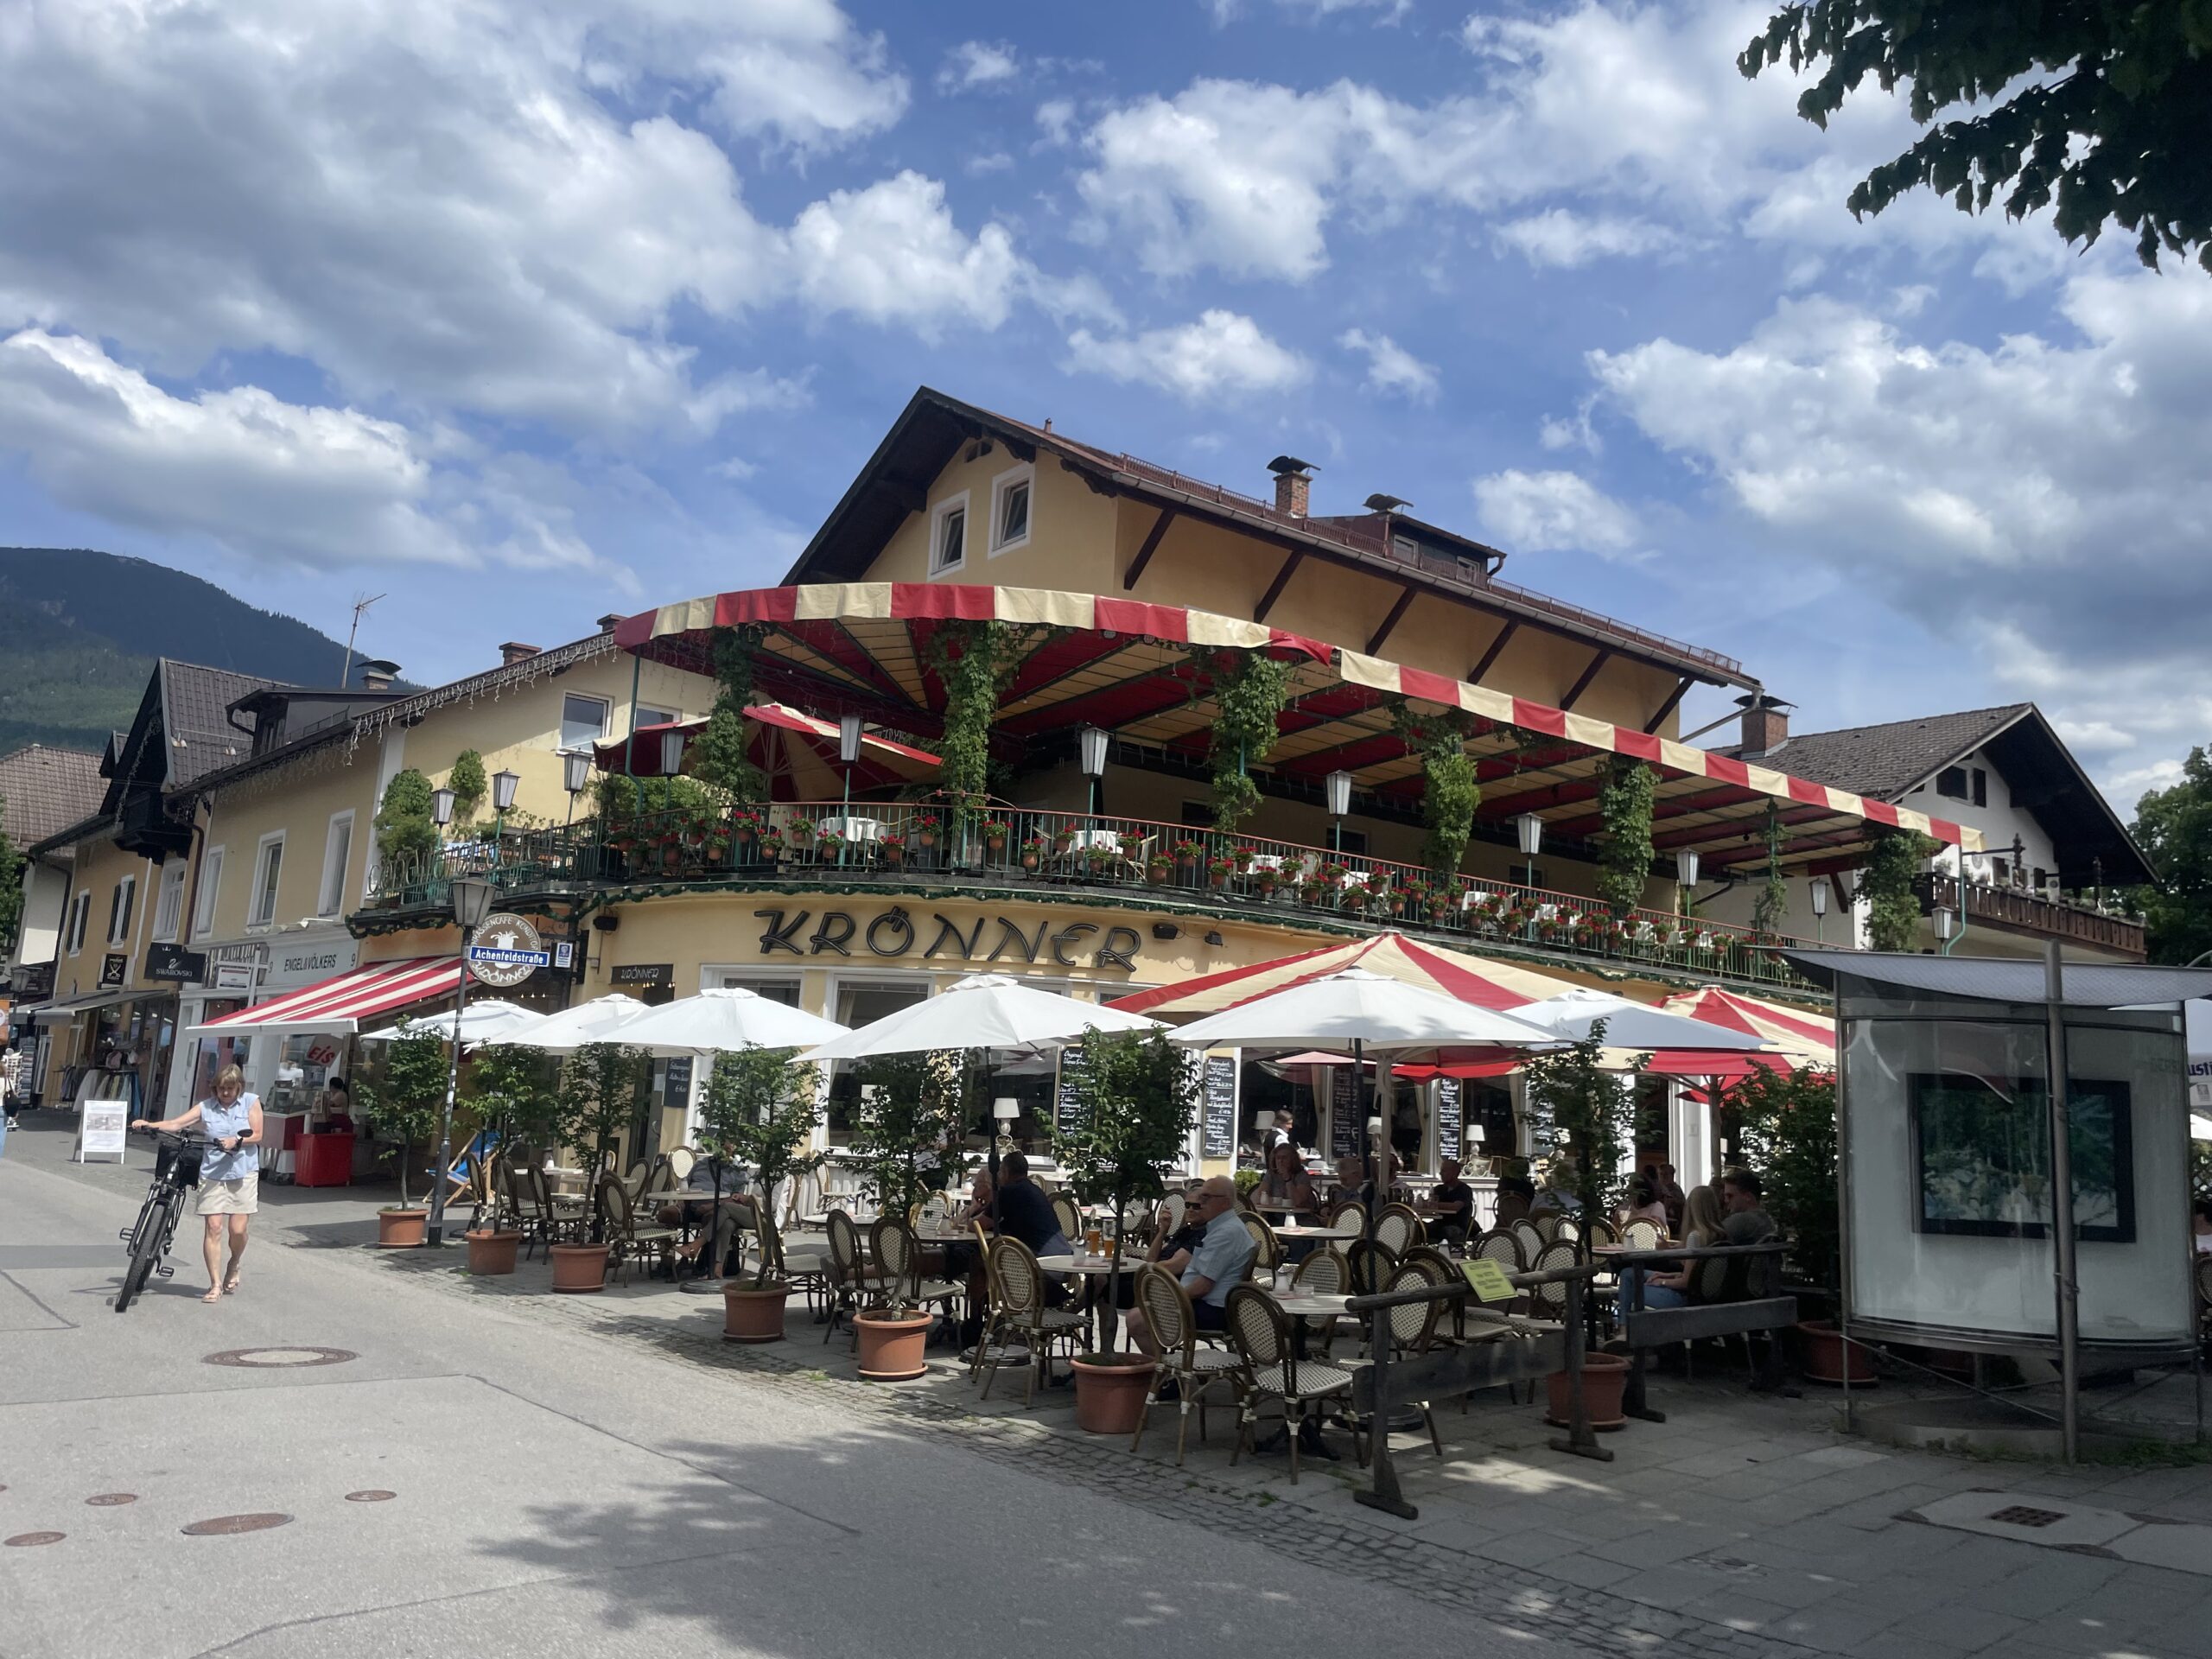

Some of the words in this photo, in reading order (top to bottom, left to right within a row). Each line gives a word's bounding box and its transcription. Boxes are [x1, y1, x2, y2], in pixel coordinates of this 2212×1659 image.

[753, 905, 1141, 973] KRÖNNER
[475, 949, 543, 964] Achenfeldstraße
[156, 968, 193, 977] SWAROVSKI
